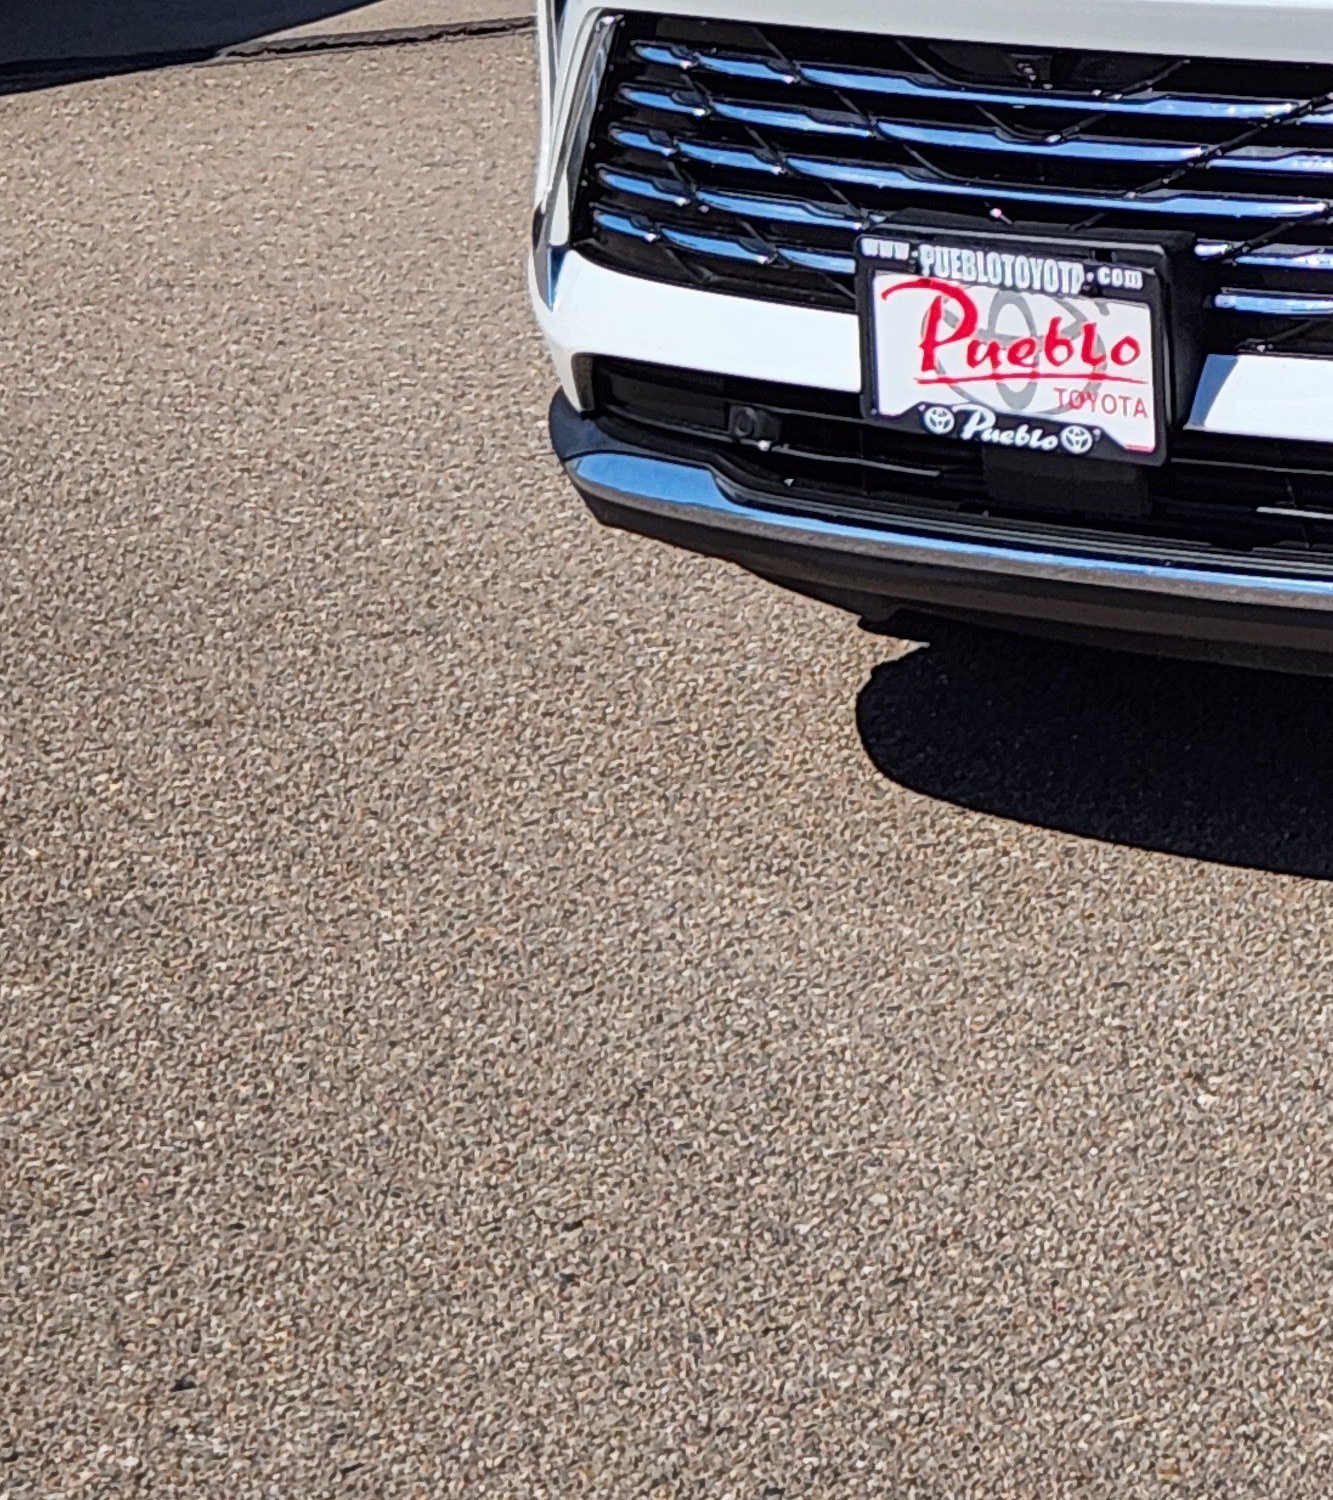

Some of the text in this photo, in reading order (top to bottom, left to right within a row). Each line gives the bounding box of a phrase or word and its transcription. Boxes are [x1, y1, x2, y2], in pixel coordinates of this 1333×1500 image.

[881, 278, 1142, 373] Pueblo
[952, 403, 1059, 451] Pueblo
[1053, 387, 1149, 419] TOYOTA
